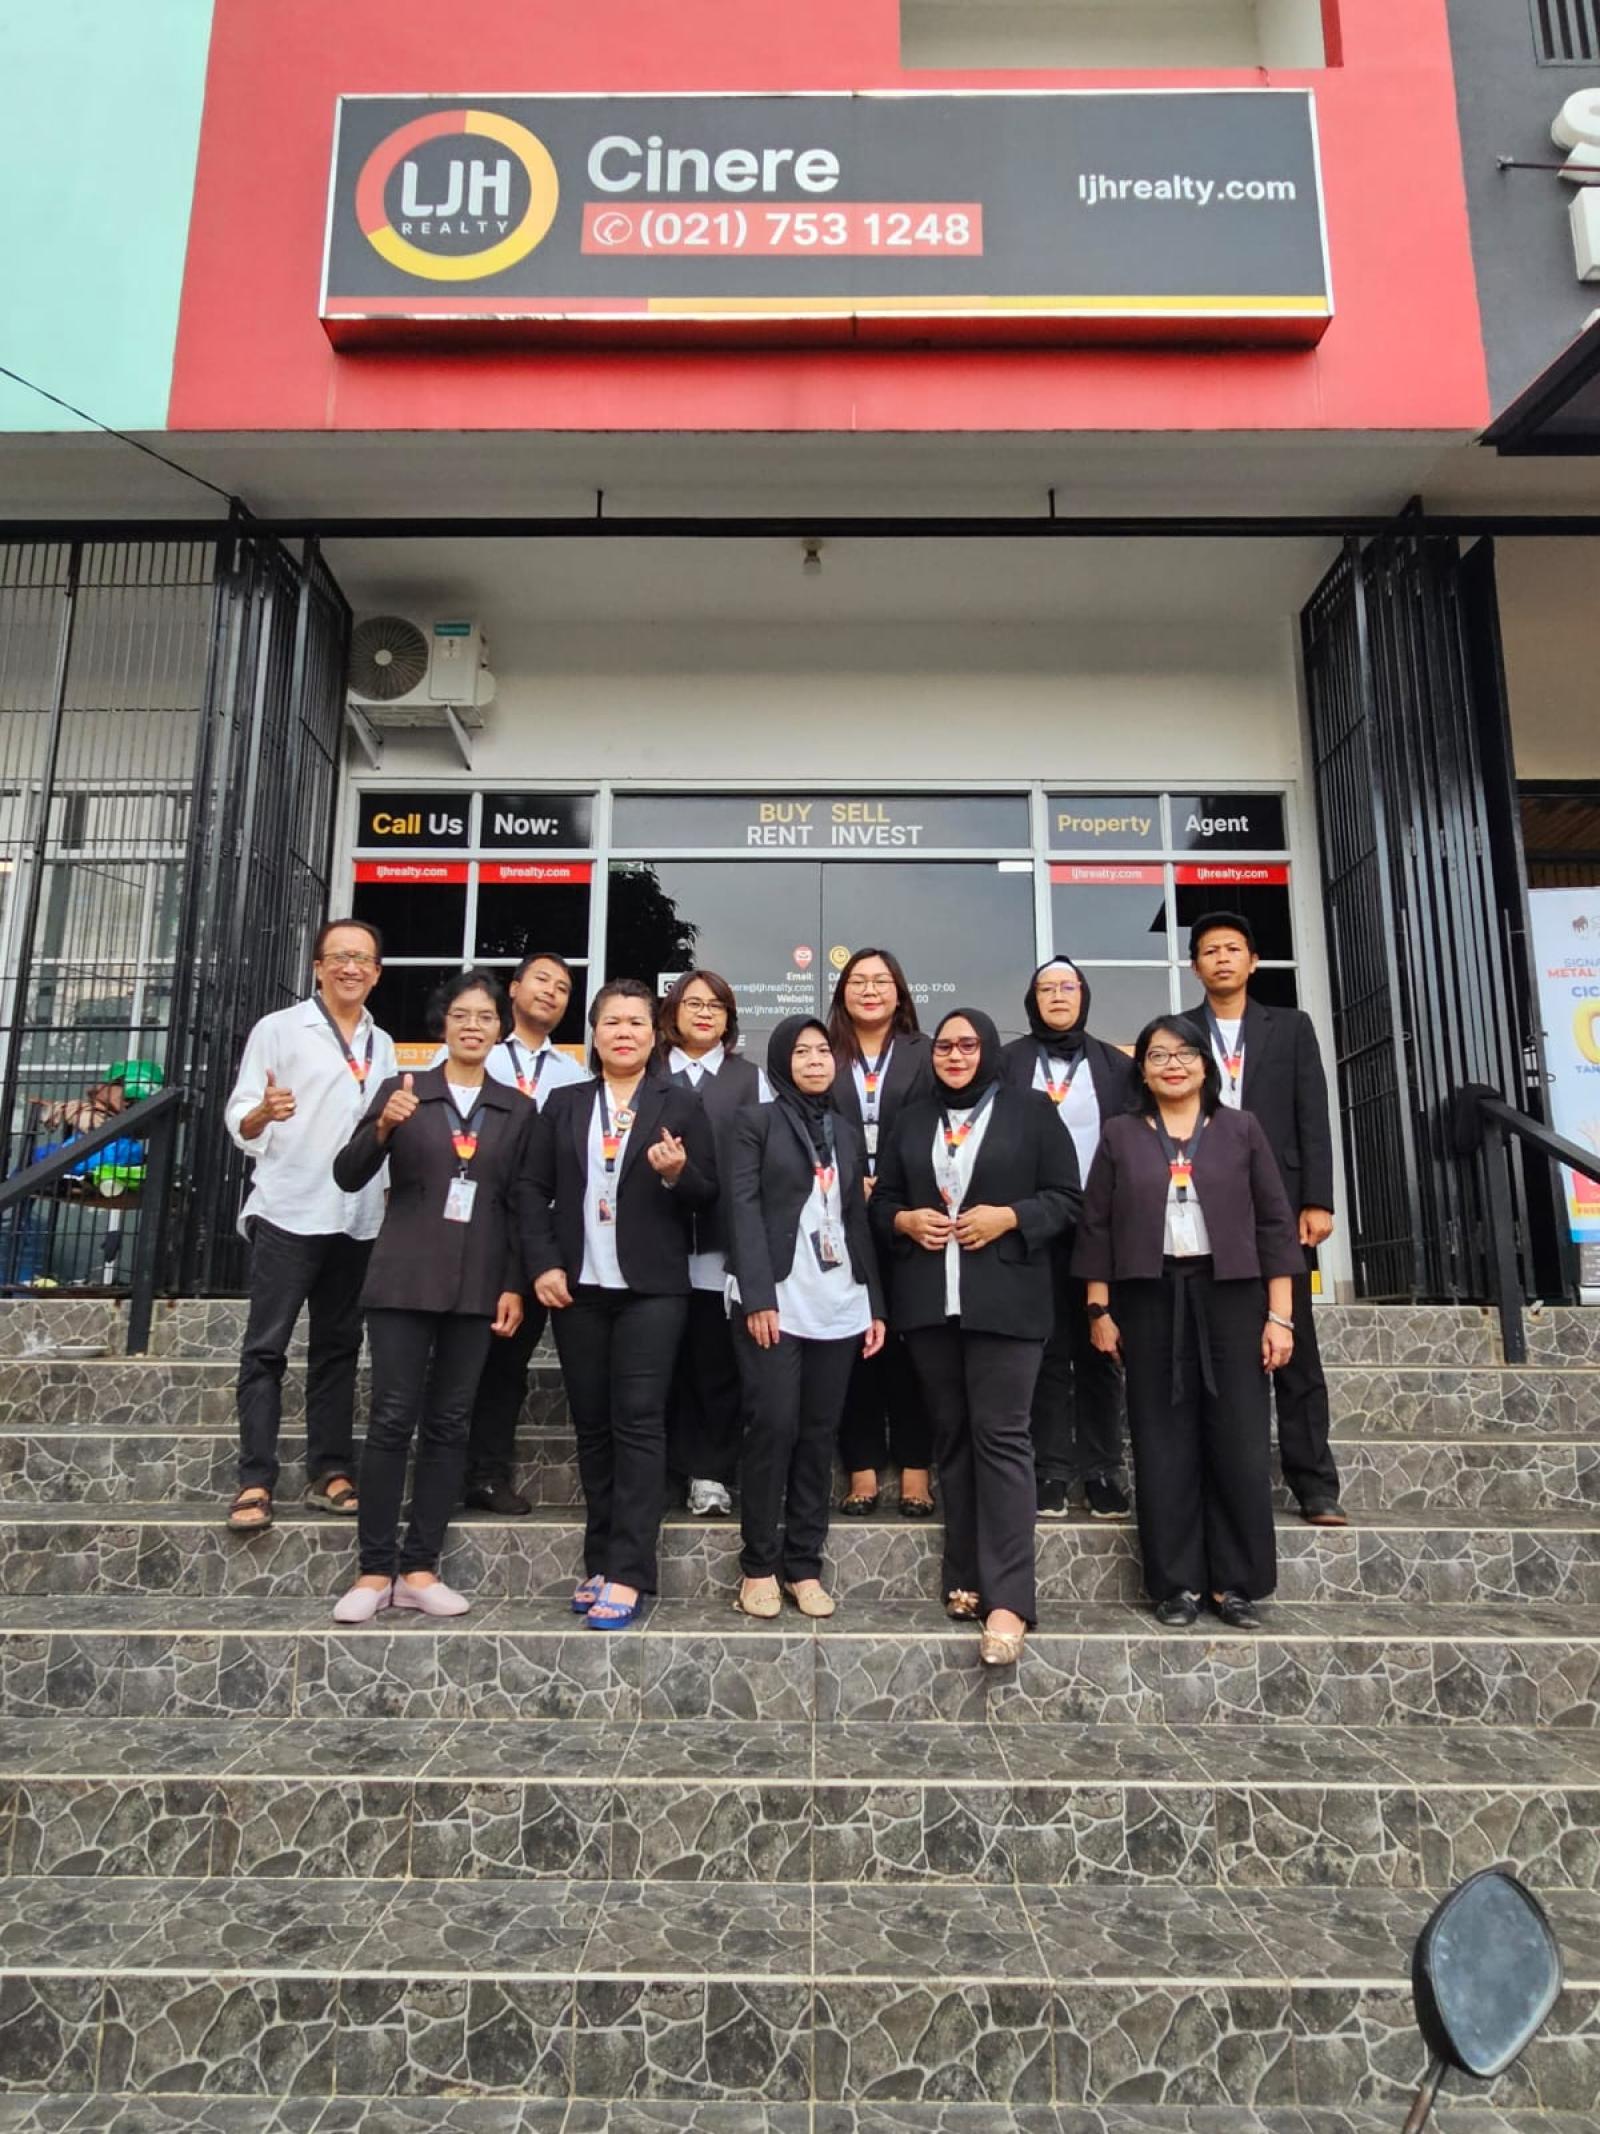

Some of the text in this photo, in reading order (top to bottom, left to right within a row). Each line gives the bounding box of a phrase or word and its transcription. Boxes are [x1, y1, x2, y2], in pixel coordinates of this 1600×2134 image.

[588, 135, 840, 193] Cinere
[401, 159, 510, 217] LJH
[1078, 174, 1296, 207] ljhrealty.com
[401, 220, 509, 235] REALTY
[640, 210, 970, 248] (021) 753 1248
[759, 802, 891, 823] BUY SELL
[372, 812, 559, 835] Call Us Now:
[1057, 814, 1249, 837] Property Agent
[747, 825, 923, 846] RENT INVEST
[376, 865, 448, 879] ljhrealty.com
[499, 865, 571, 879] ljhrealty.com
[1071, 867, 1143, 881] ljhrealty.com
[1196, 867, 1269, 881] ljhrealty.com
[786, 971, 814, 982] Email:
[1548, 968, 1597, 978] METAL
[776, 993, 815, 1004] Website
